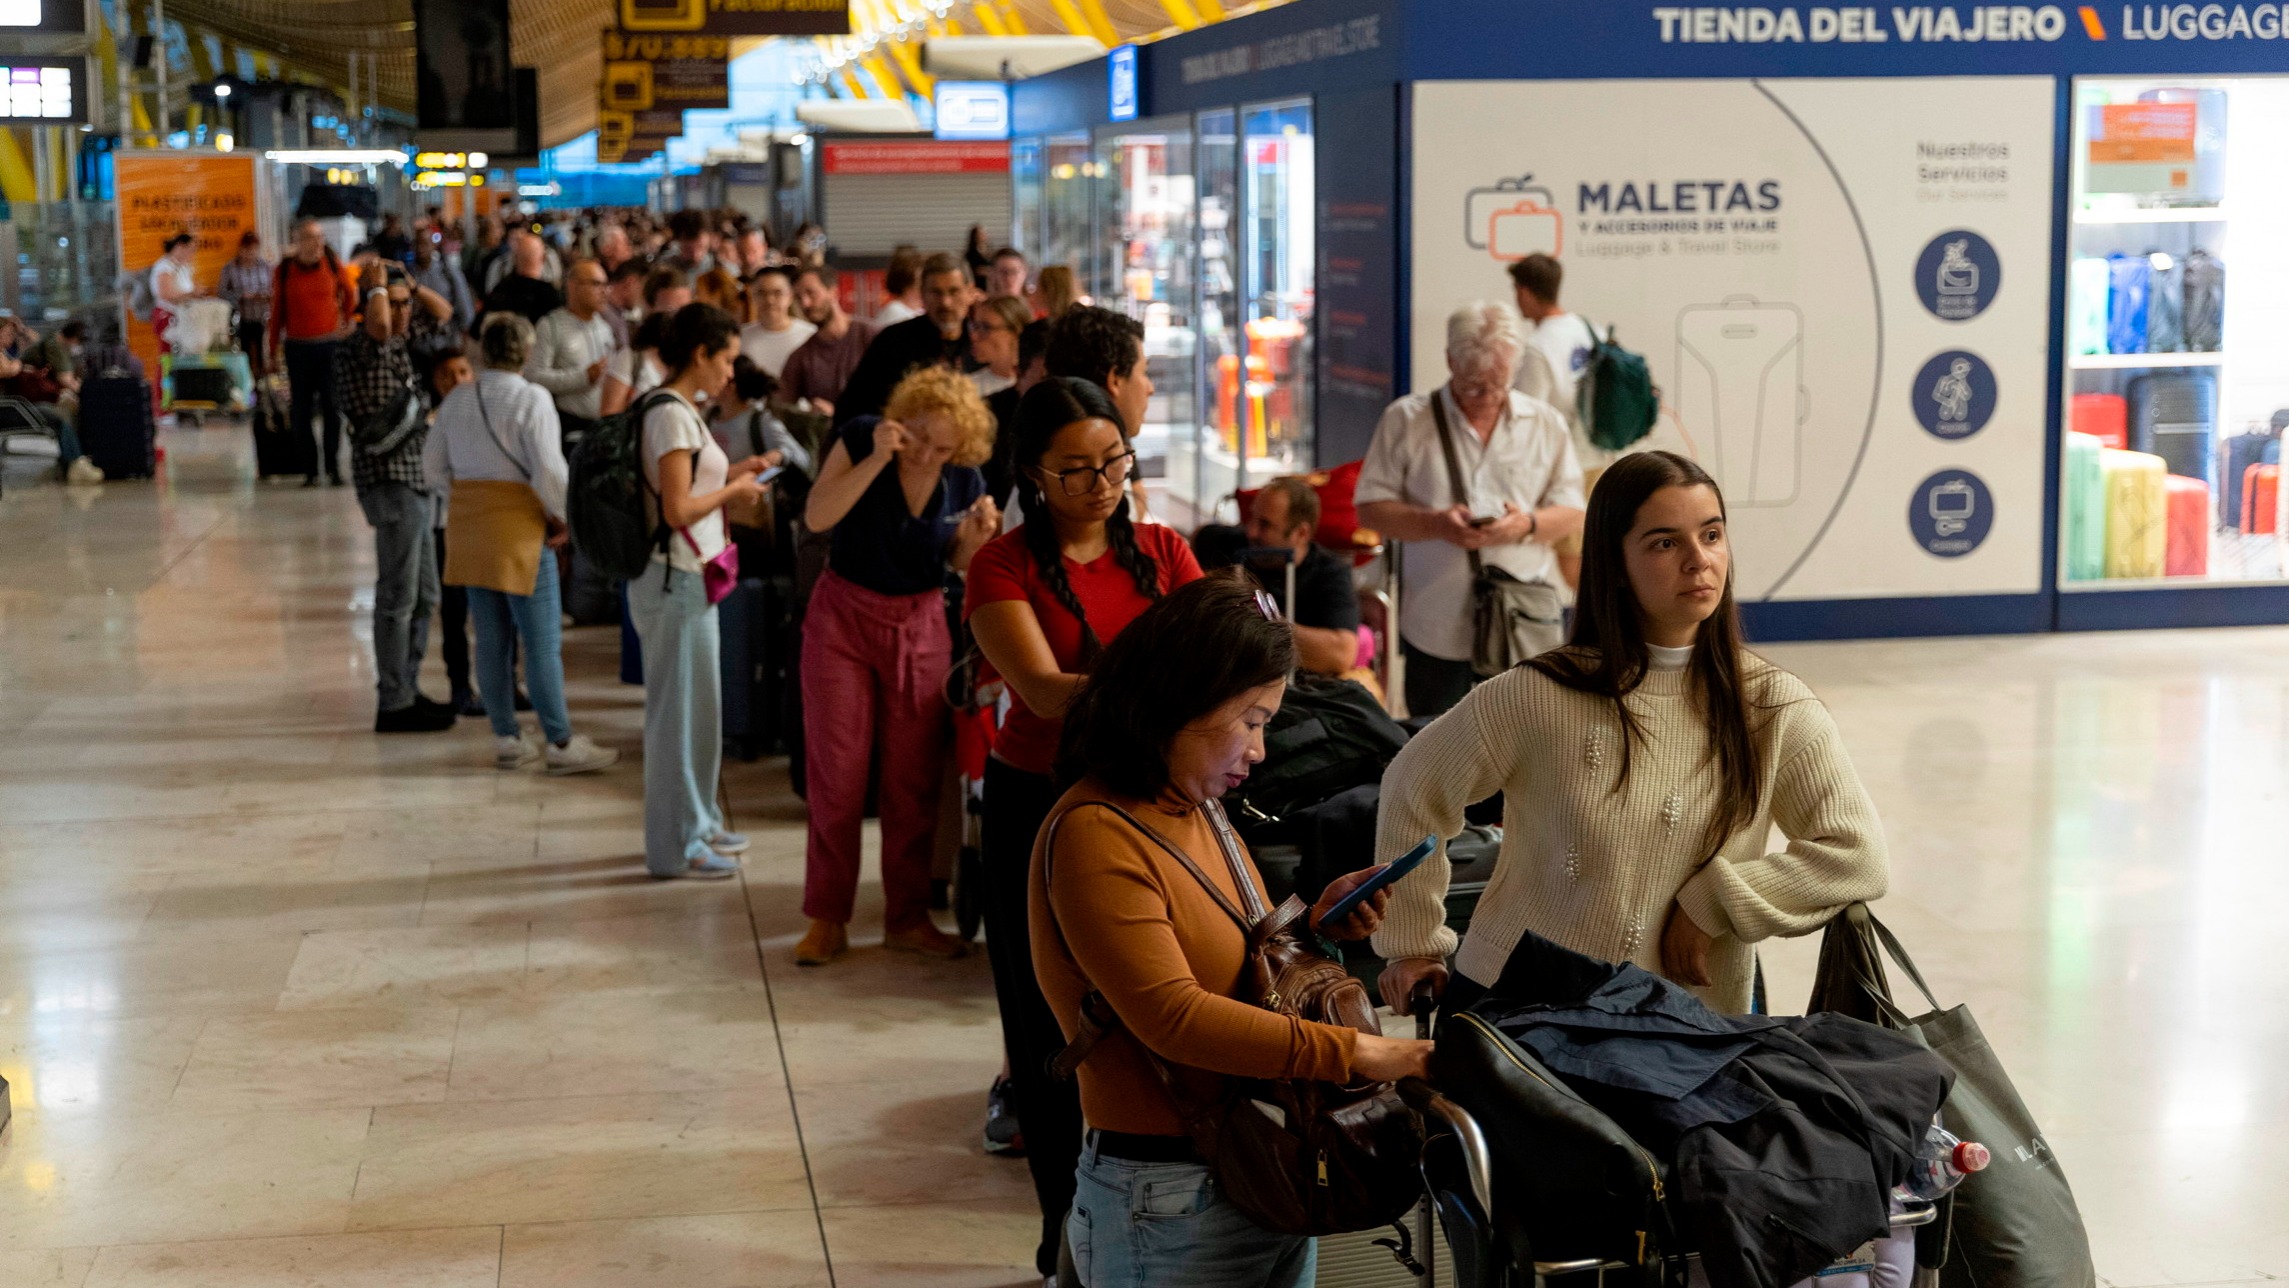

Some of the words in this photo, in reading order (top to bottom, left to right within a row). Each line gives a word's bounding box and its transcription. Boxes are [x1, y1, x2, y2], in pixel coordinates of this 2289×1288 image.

[1653, 7, 1805, 42] TIENDA
[1810, 7, 1888, 42] DEL
[1892, 5, 2066, 42] VIAJERO
[2123, 4, 2289, 40] LUGGAG
[1917, 140, 2009, 159] Nuestros
[1917, 163, 2009, 182] Servicios
[1578, 181, 1781, 214] MALETAS
[1597, 220, 1698, 234] ACCESORIOS
[1703, 220, 1726, 233] DE
[1730, 219, 1779, 233] VIAJE
